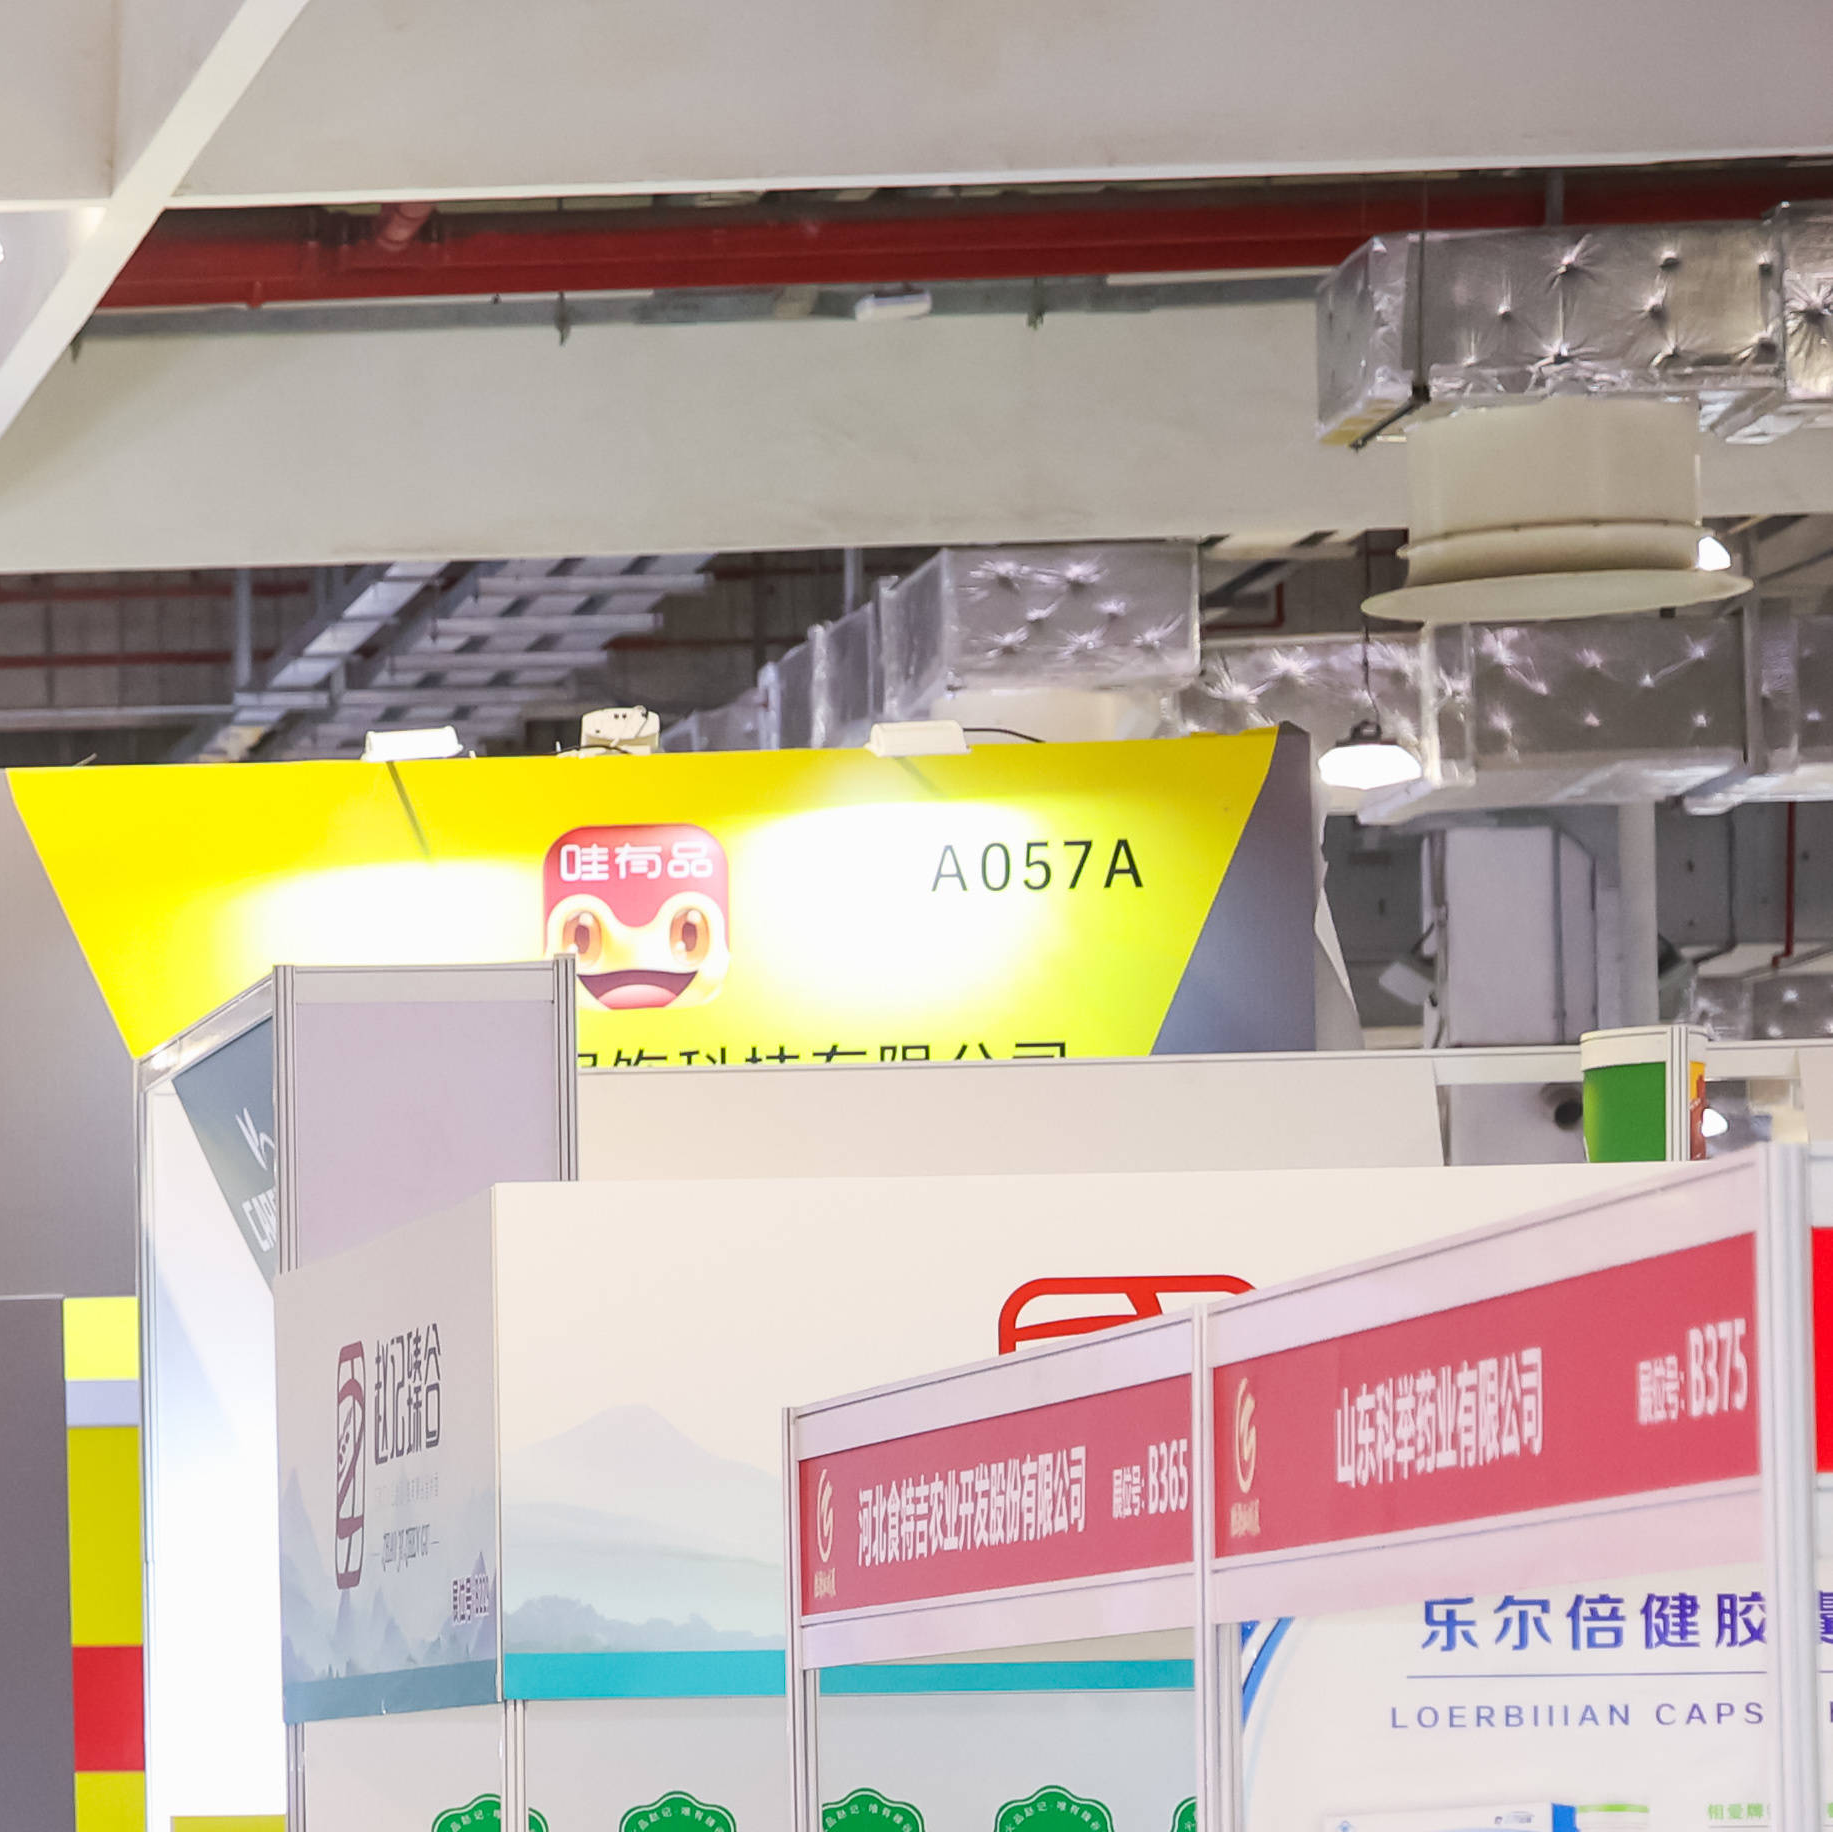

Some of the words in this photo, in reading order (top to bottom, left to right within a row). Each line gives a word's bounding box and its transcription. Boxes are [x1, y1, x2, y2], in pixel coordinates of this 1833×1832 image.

[560, 843, 714, 882] 哇有品
[932, 839, 1144, 892] A057A
[1688, 1318, 1748, 1418] B375
[857, 1444, 1087, 1567] 河北食特吉农业开发股份有限公司
[1147, 1438, 1189, 1515] B365
